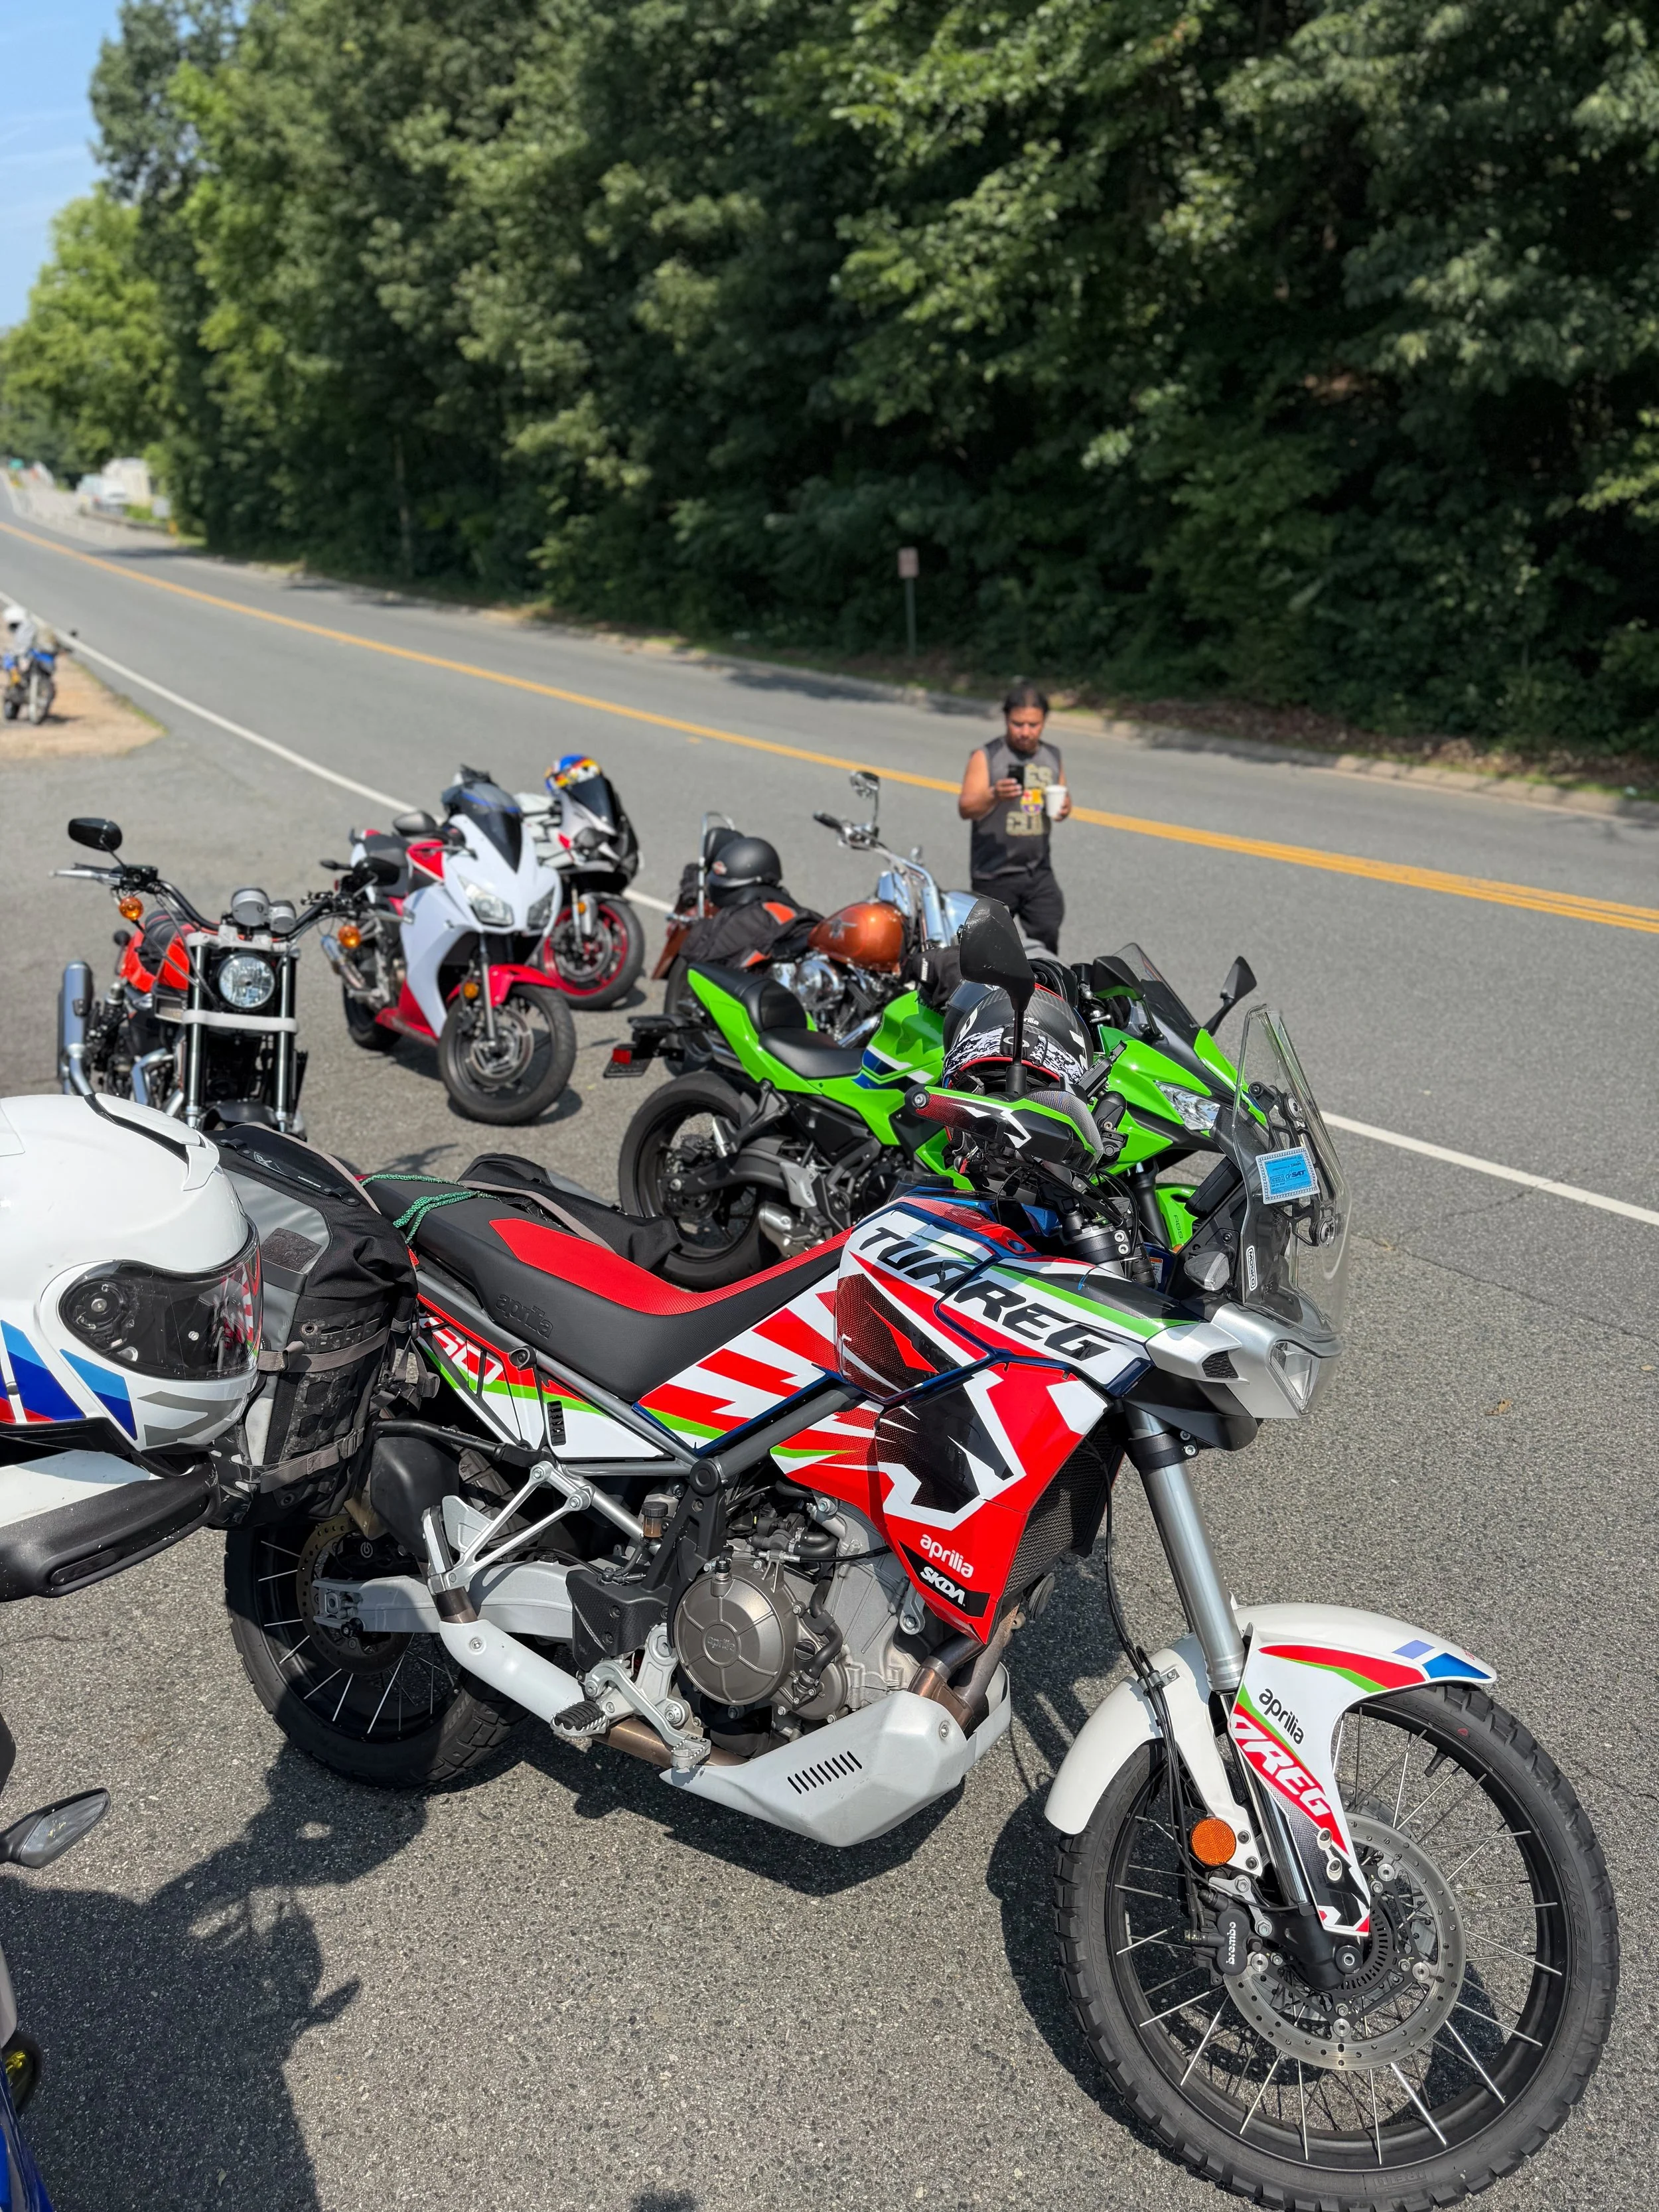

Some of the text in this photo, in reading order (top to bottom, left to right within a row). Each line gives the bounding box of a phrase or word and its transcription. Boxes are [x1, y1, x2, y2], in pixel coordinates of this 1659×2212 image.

[496, 1294, 554, 1340] aprilia
[920, 1534, 974, 1578] aprilia
[920, 1566, 966, 1605] SKDA
[1259, 1688, 1305, 1745] aprilia
[1225, 1921, 1237, 1965] brembo
